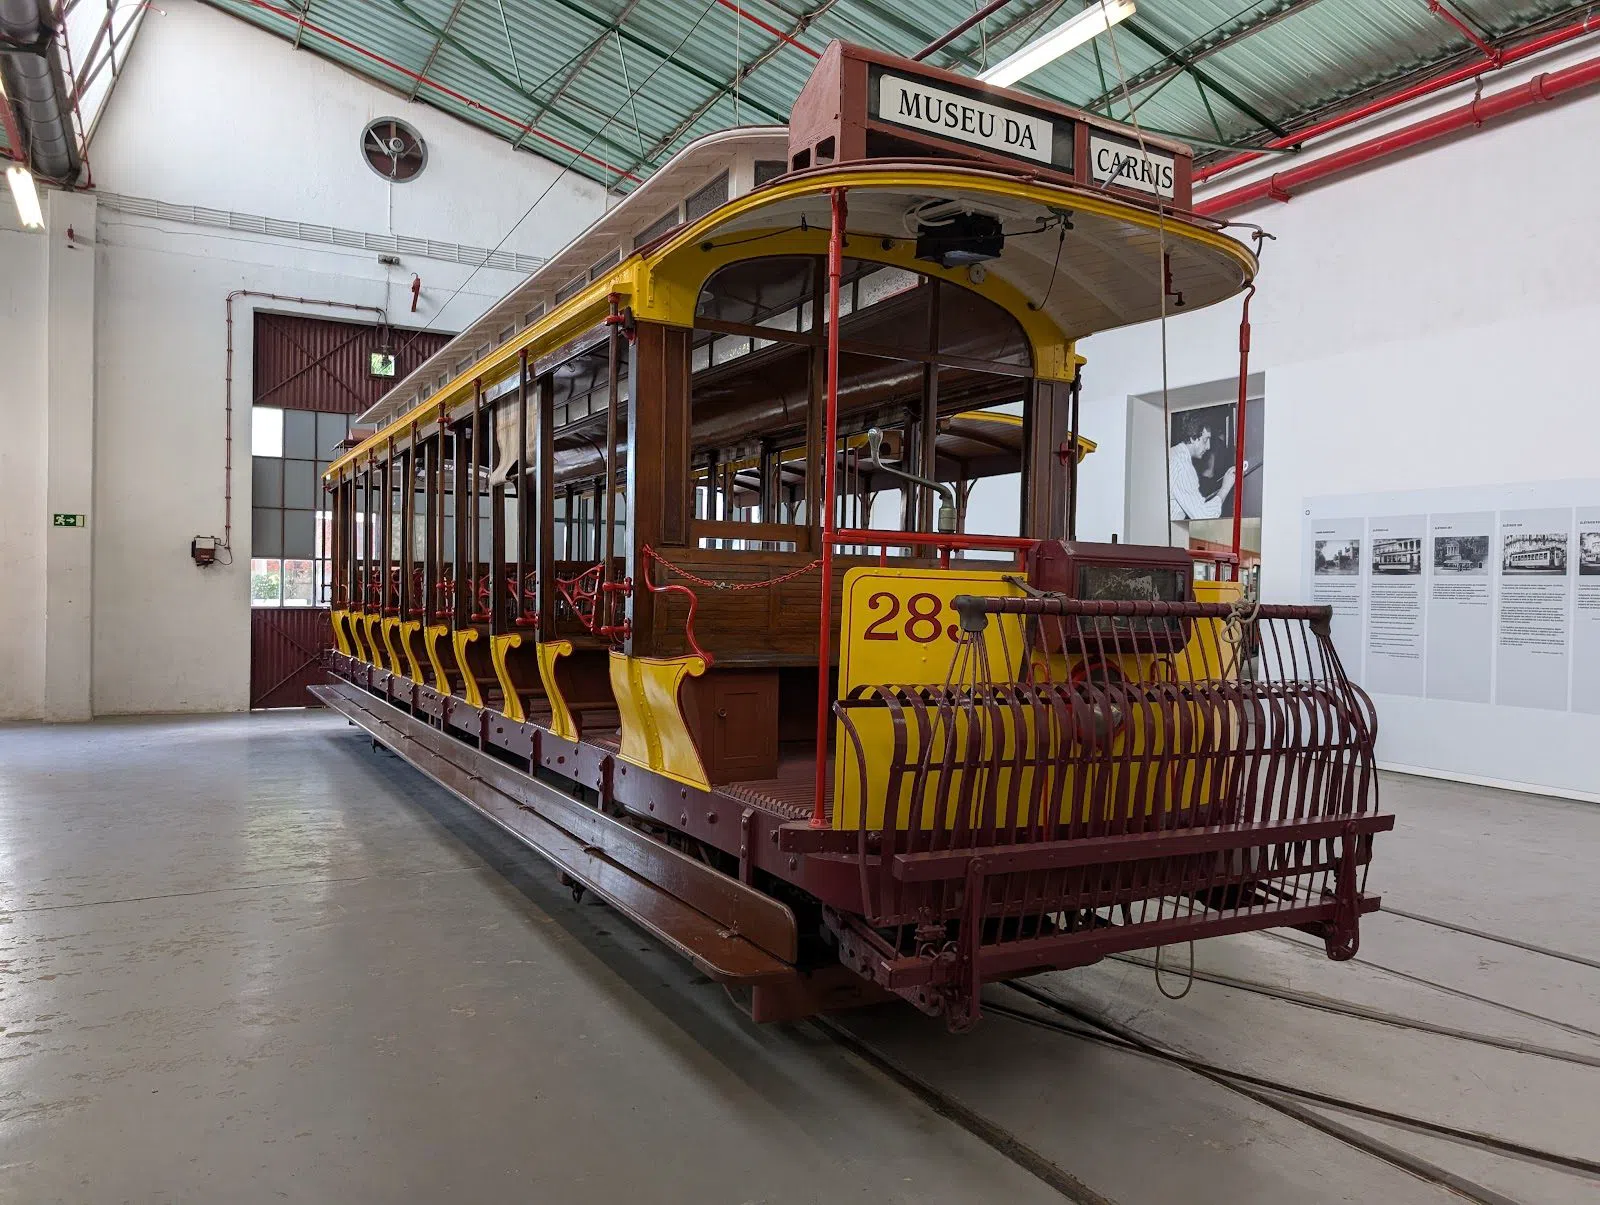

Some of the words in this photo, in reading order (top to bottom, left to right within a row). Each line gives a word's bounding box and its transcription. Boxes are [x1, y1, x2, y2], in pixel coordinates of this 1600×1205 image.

[898, 88, 995, 138] MUSEU
[1004, 117, 1037, 151] DA
[1097, 148, 1173, 189] CARRIS
